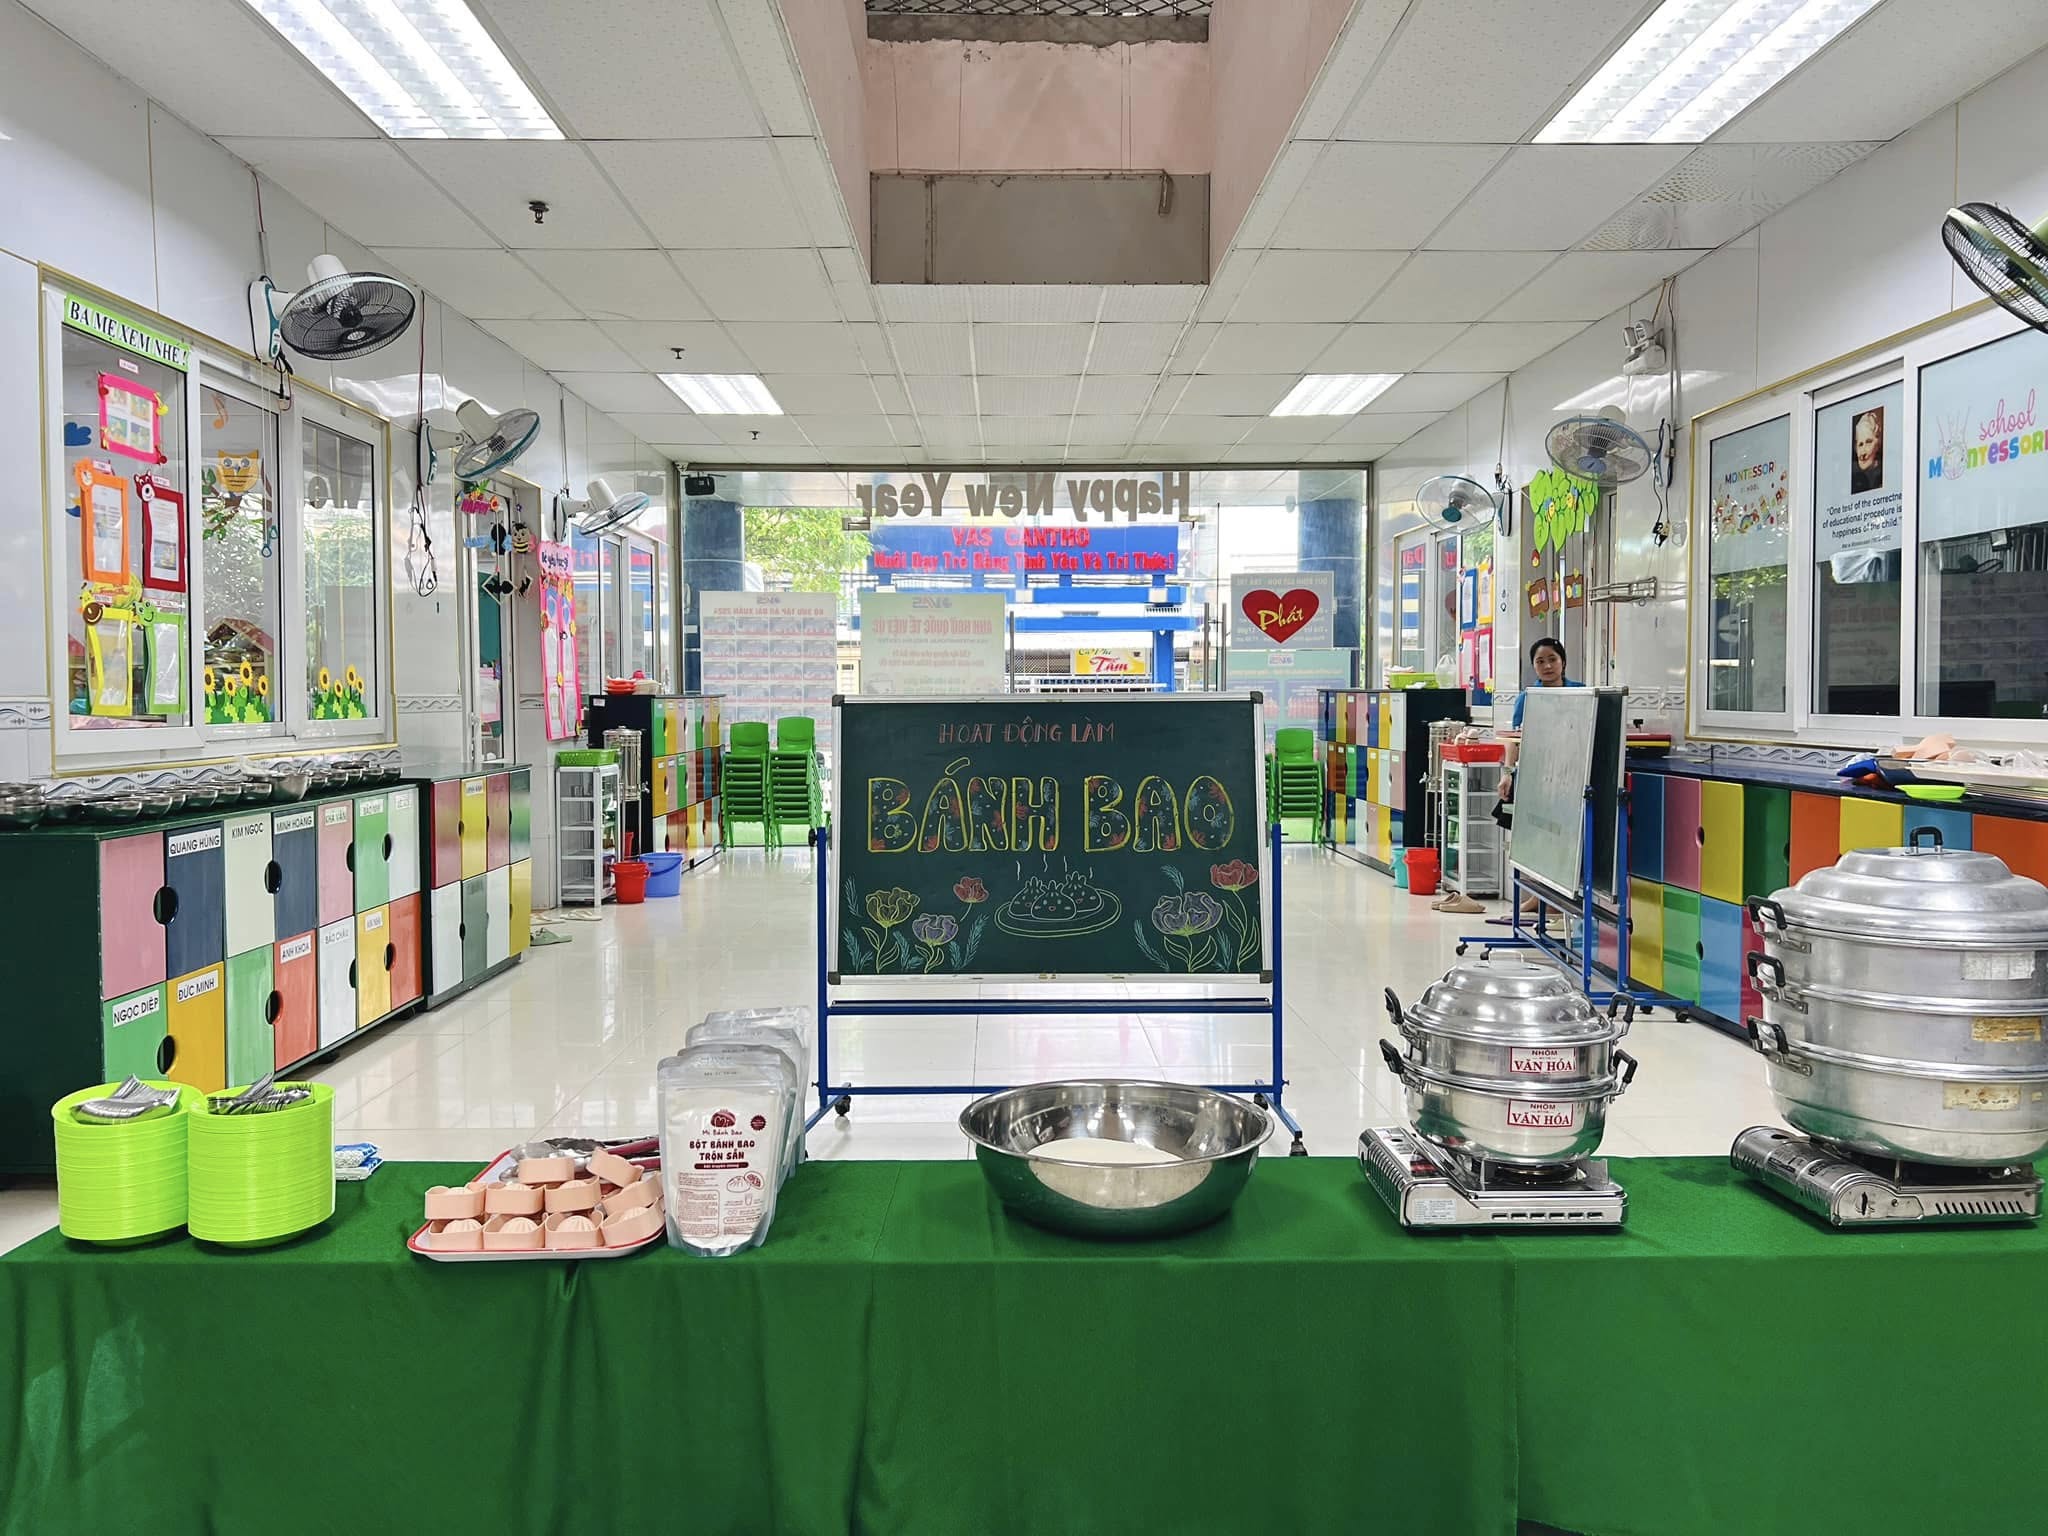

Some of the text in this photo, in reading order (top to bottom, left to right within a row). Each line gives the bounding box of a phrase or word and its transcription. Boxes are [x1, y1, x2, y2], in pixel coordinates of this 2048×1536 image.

[70, 300, 90, 326] BA
[120, 323, 151, 353] XEM
[1978, 387, 2037, 441] school
[951, 526, 1091, 548] VAS CANTHO
[1001, 715, 1064, 748] ĐỘNG
[1071, 716, 1116, 743] LÀM
[866, 756, 1236, 853] BÁNH BAO
[231, 824, 244, 840] KIM
[169, 839, 198, 855] QUANG
[196, 977, 215, 993] MINH
[1514, 1057, 1573, 1072] VĂN HÓA
[1511, 1111, 1569, 1126] VĂN HÓA
[710, 1137, 735, 1149] BÁNH
[737, 1139, 756, 1148] BAO
